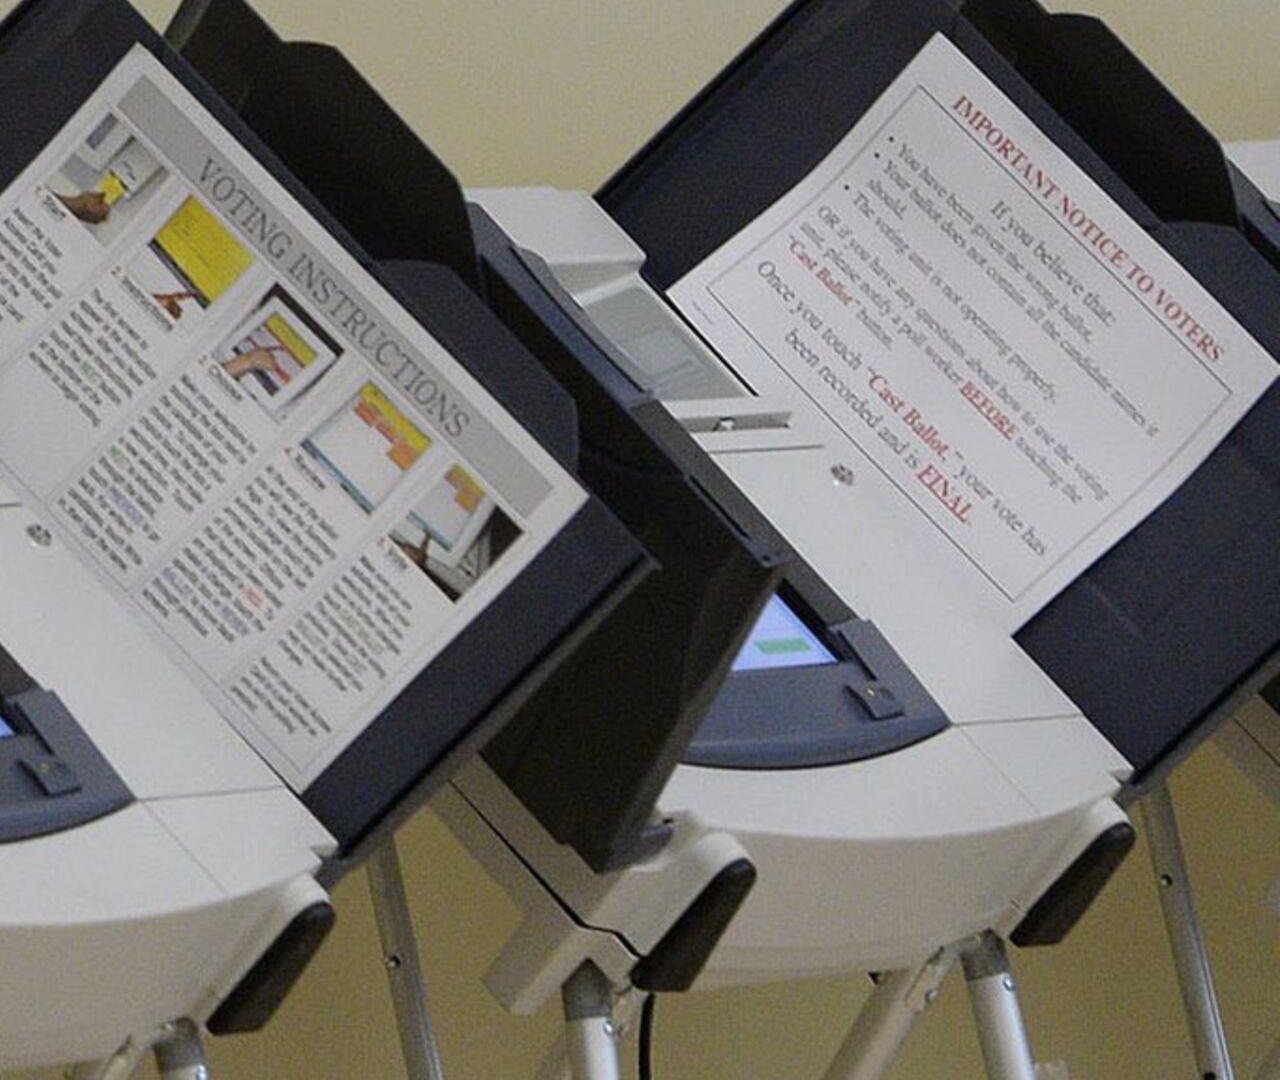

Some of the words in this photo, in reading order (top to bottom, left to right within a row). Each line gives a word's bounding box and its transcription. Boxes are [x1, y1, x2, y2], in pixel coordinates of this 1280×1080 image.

[199, 158, 294, 260] VOTING
[290, 252, 471, 438] INSTRUCTIONS
[952, 95, 1061, 200] IMPORTANT
[1055, 196, 1129, 269] NOTICE
[1126, 262, 1155, 294] TO
[1154, 289, 1224, 361] VOTERS
[991, 201, 1010, 221] If
[1001, 219, 1033, 248] you
[1033, 241, 1083, 296] believe
[758, 261, 795, 304] Once
[790, 302, 823, 332] you
[822, 328, 863, 370] touch
[953, 466, 992, 499] your
[992, 498, 1025, 531] vote
[1022, 527, 1046, 556] has
[785, 328, 819, 366] been
[819, 365, 884, 428] recorded
[877, 425, 907, 456] and
[904, 452, 920, 469] is
[960, 381, 1020, 441] BEFORE
